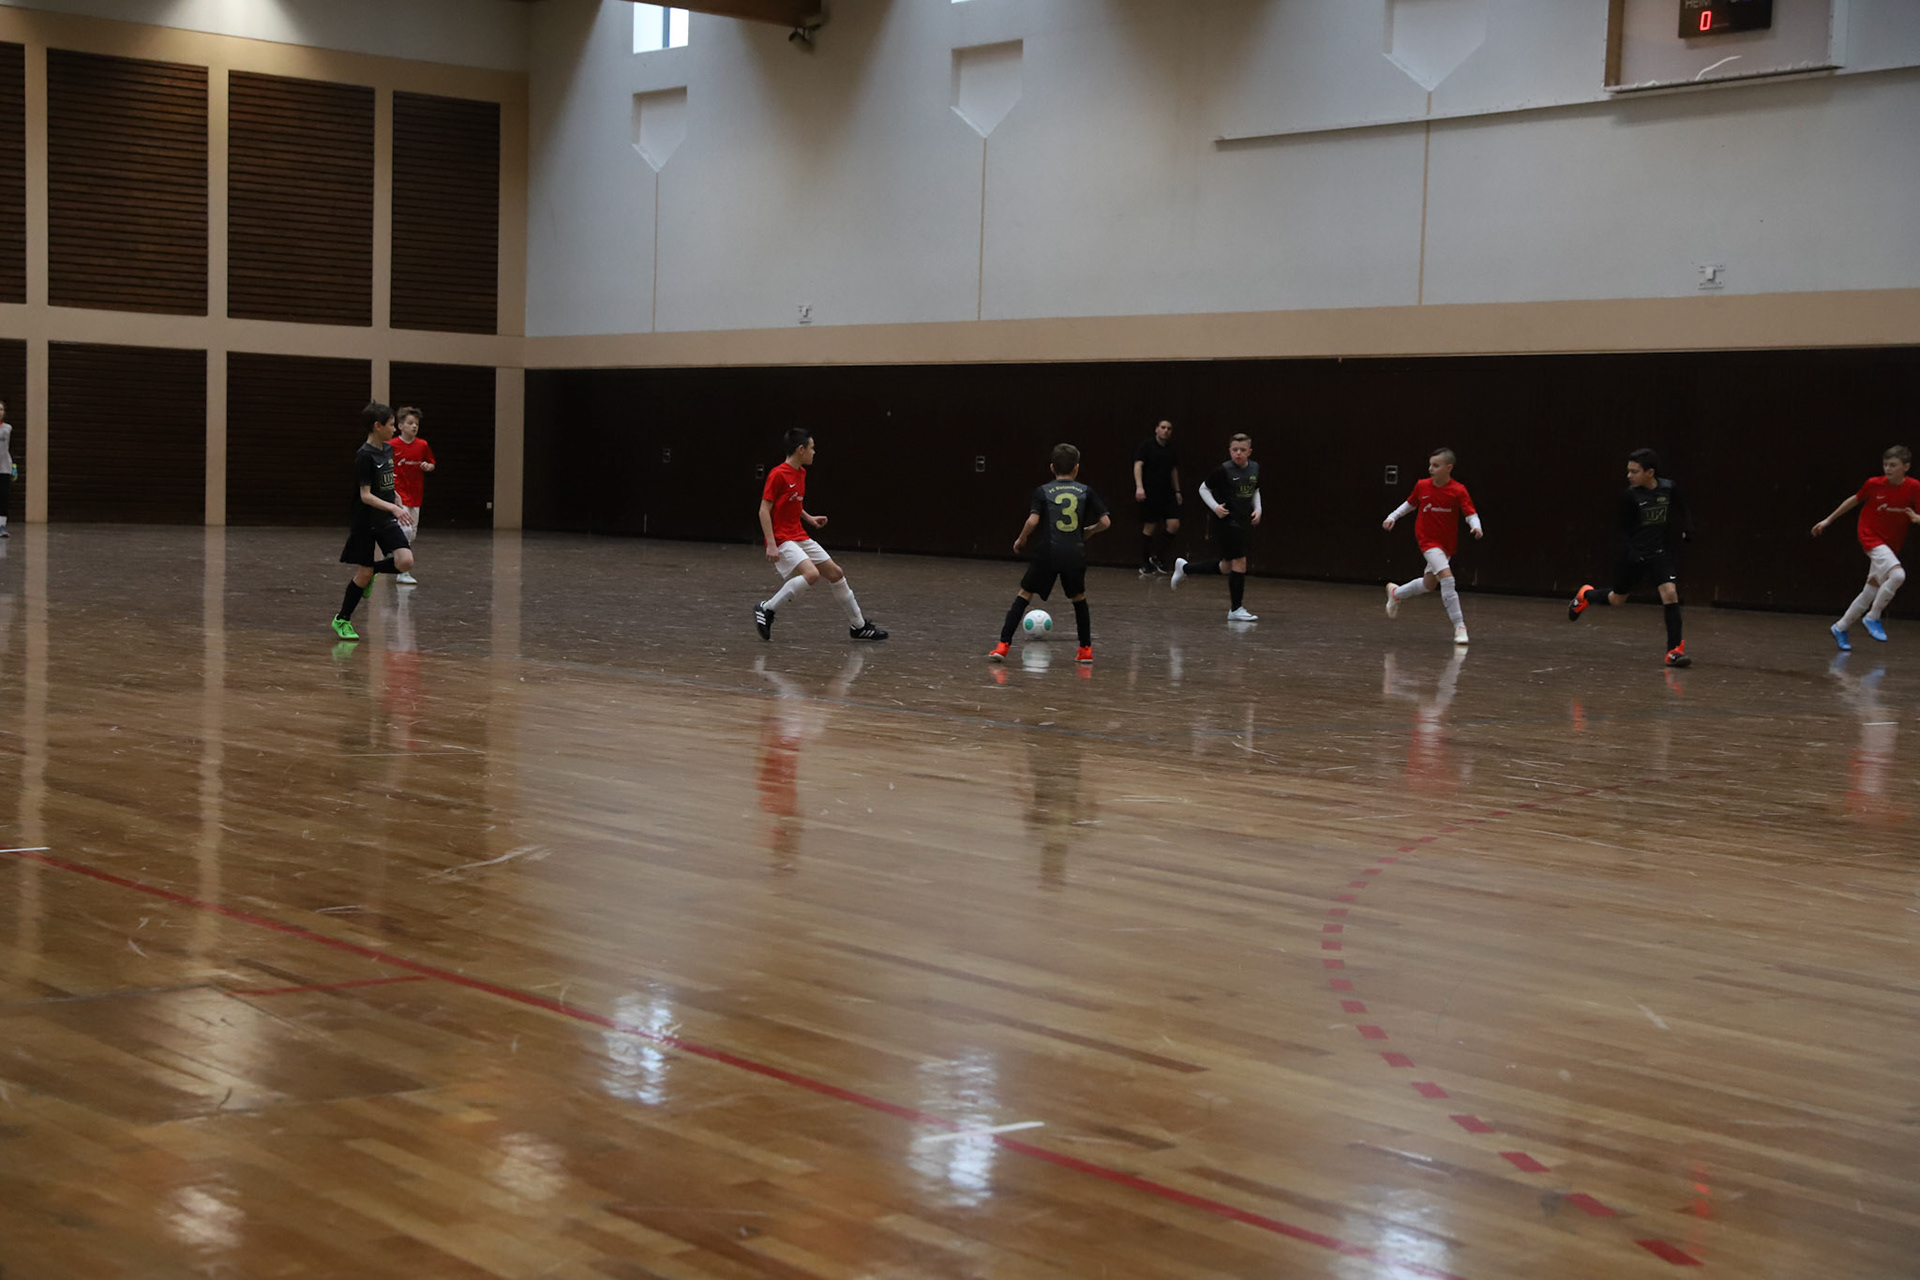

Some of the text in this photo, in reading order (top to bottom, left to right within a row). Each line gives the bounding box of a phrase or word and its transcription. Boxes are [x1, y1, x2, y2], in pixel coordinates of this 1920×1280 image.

[1685, 0, 1712, 9] HEIM
[1699, 10, 1712, 31] 0
[1055, 492, 1078, 532] 3
